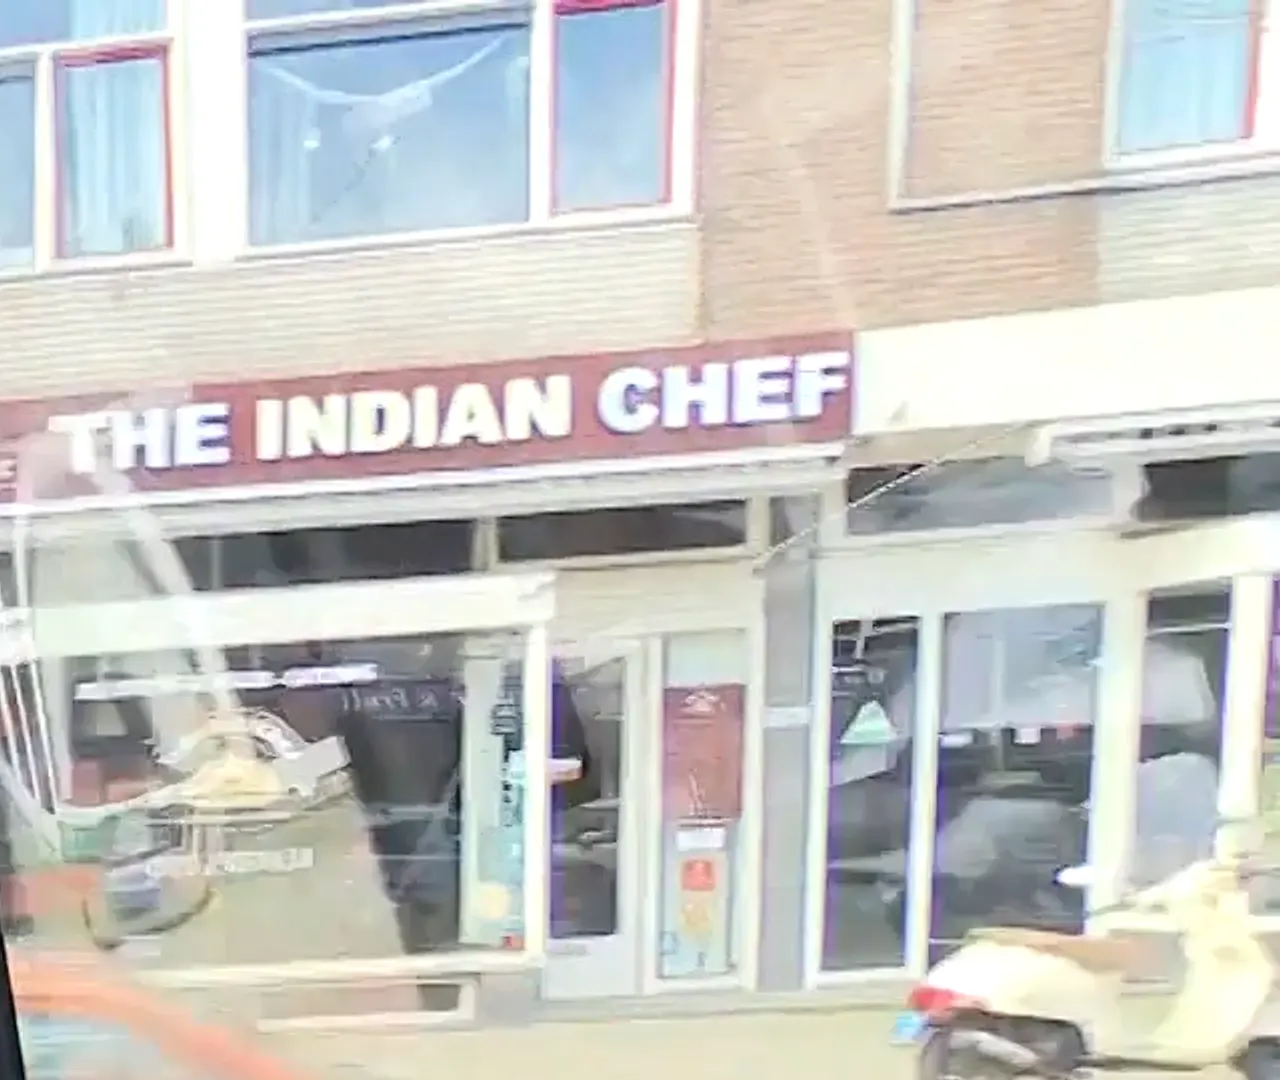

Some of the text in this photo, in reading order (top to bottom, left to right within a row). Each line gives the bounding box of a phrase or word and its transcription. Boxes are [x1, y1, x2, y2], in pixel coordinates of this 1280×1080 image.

[47, 350, 850, 473] THE INDIAN CHEF
